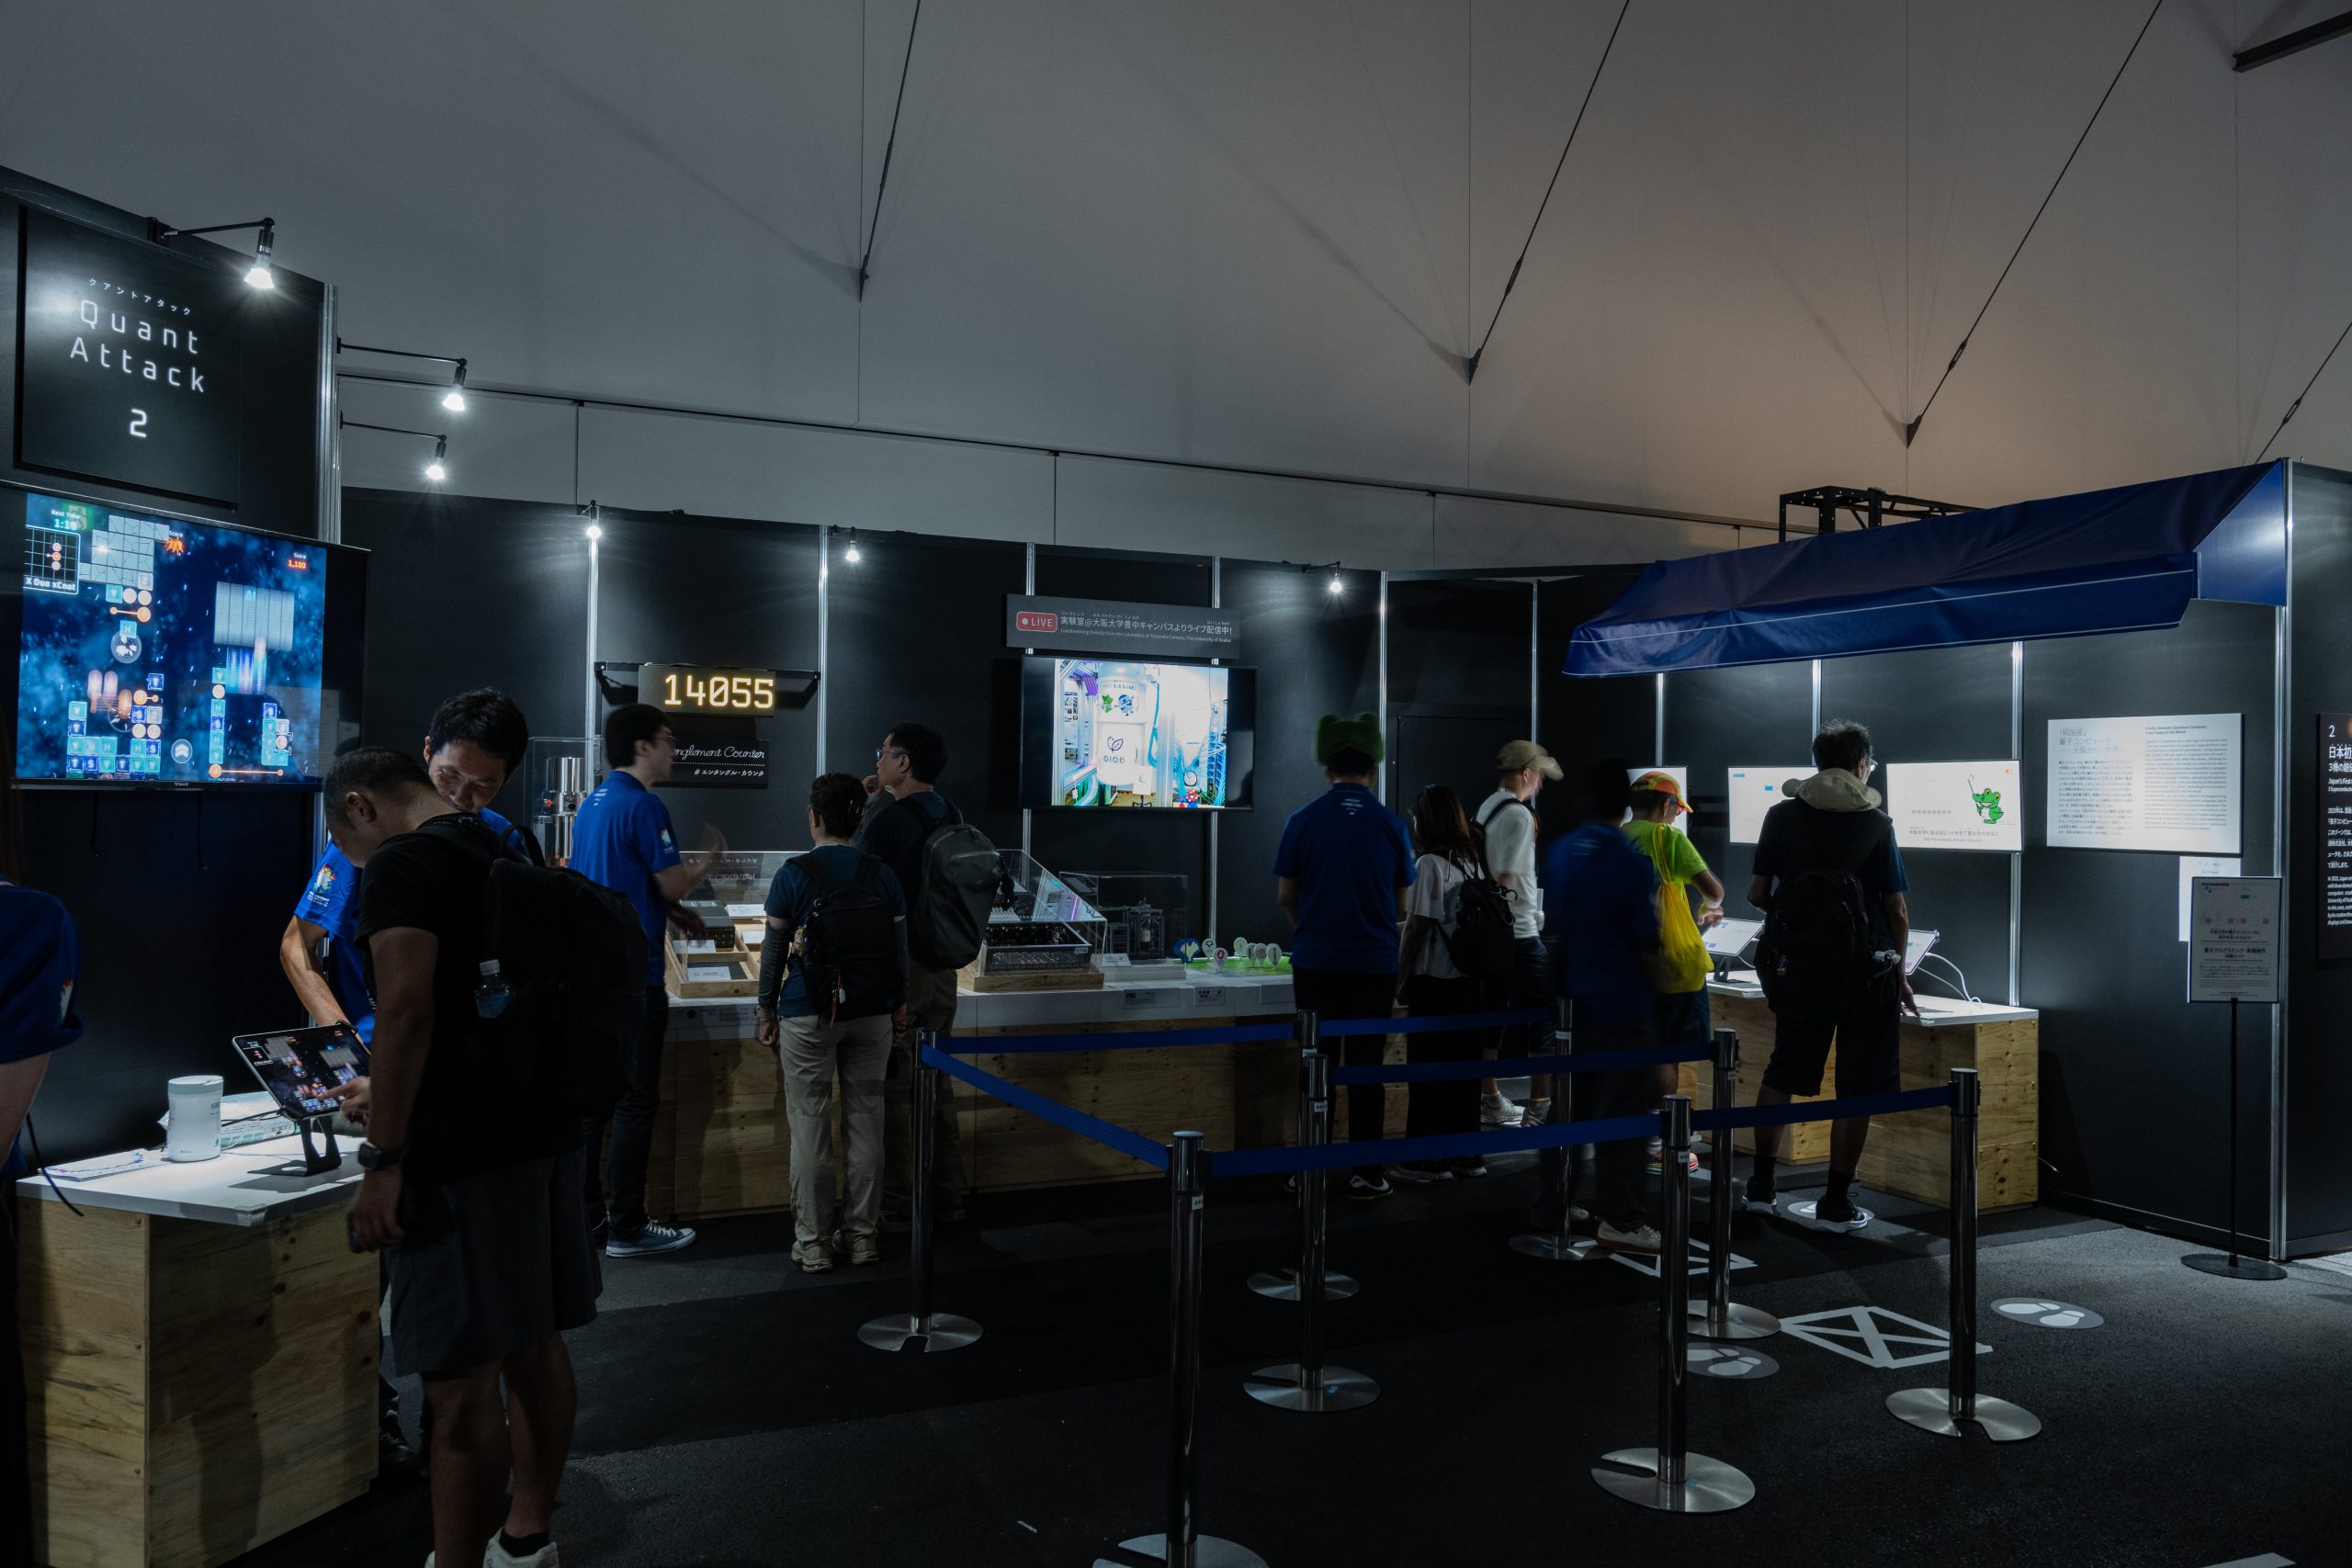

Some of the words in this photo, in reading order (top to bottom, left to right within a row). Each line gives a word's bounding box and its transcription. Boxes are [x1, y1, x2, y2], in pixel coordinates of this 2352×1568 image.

[89, 278, 191, 316] クアントアタック
[80, 299, 198, 355] Quant
[70, 336, 205, 393] Attack
[129, 408, 149, 439] 2
[1030, 617, 1054, 627] LIVE
[663, 674, 775, 708] 14055
[2328, 725, 2335, 738] 2
[673, 744, 722, 761] nglement
[723, 746, 765, 759] Counter
[2329, 746, 2352, 760] 日本初
